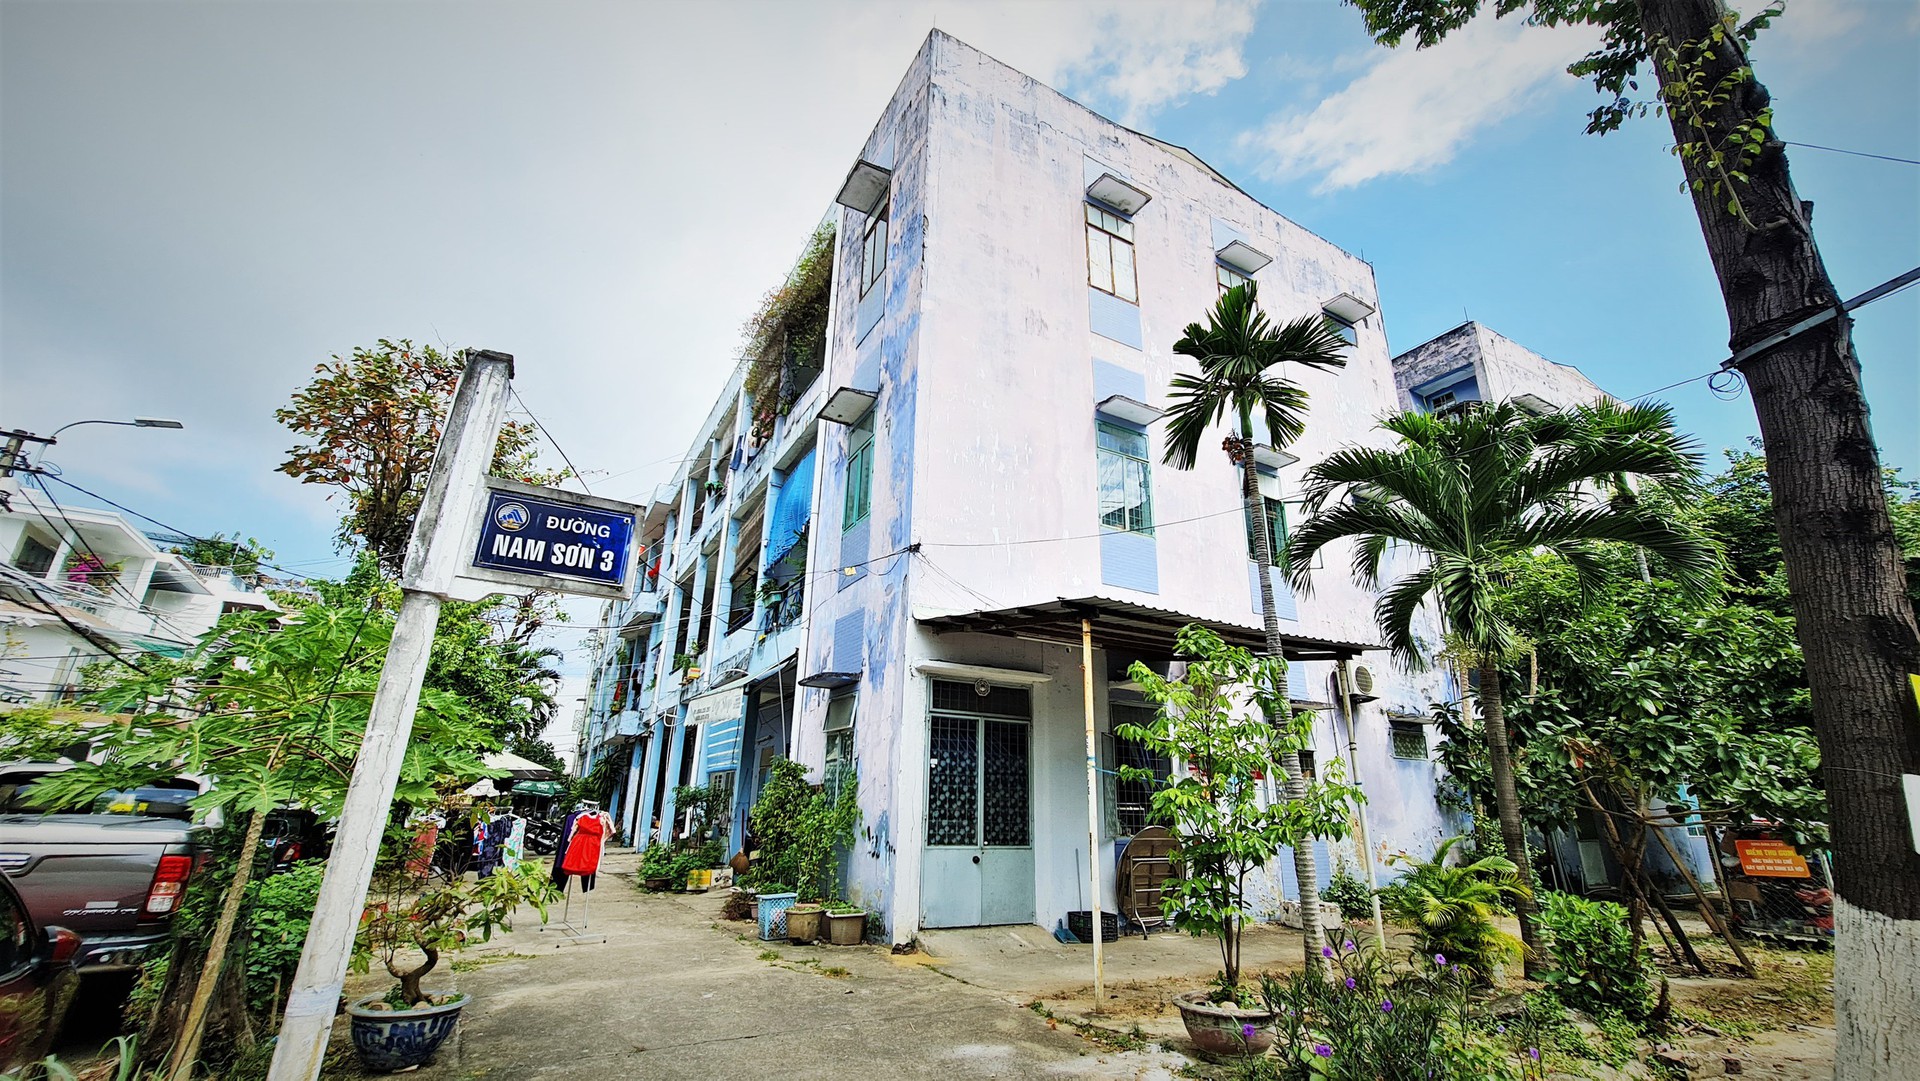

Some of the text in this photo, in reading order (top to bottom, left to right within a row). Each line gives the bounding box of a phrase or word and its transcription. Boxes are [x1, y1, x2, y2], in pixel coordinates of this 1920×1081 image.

[546, 515, 611, 538] ĐƯỜNG
[491, 533, 615, 572] NAM SƠN 3
